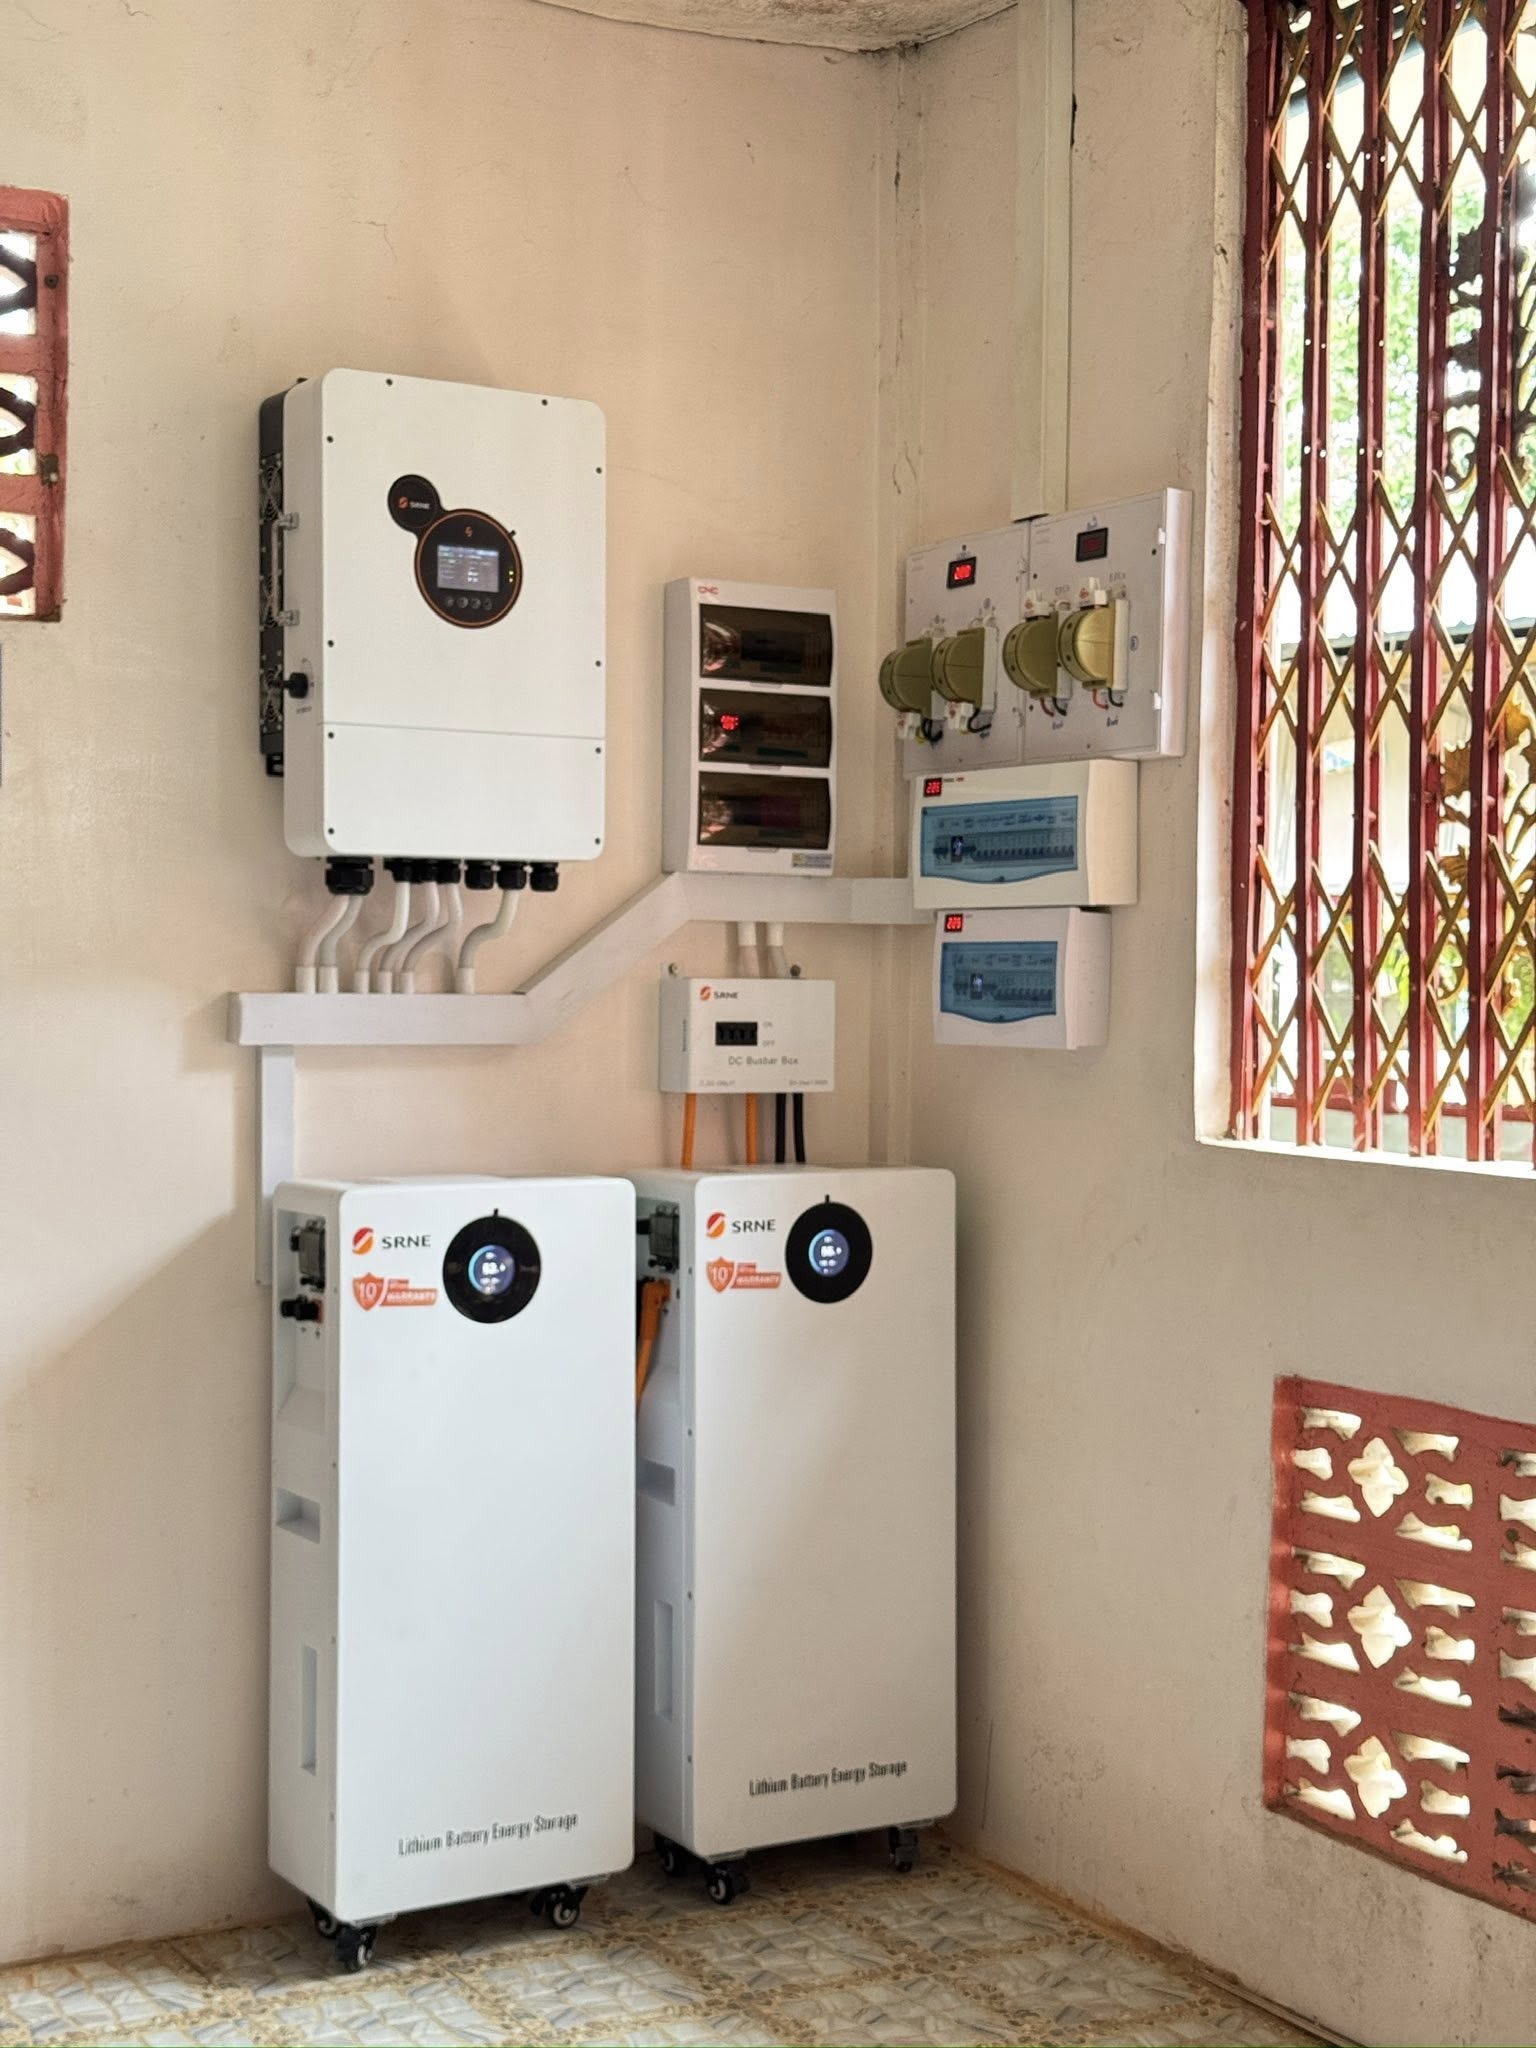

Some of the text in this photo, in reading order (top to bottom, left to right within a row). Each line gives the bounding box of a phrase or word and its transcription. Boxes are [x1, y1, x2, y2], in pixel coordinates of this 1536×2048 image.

[728, 1056, 741, 1065] DC
[781, 1056, 799, 1065] Box
[730, 1219, 776, 1233] SRNE
[381, 1235, 431, 1249] SRNE
[711, 1267, 728, 1280] 10
[358, 1283, 377, 1298] 10
[749, 1761, 907, 1796] Lithium Battery Energy Storage
[398, 1814, 579, 1856] Lithium Battery Energy Storage
